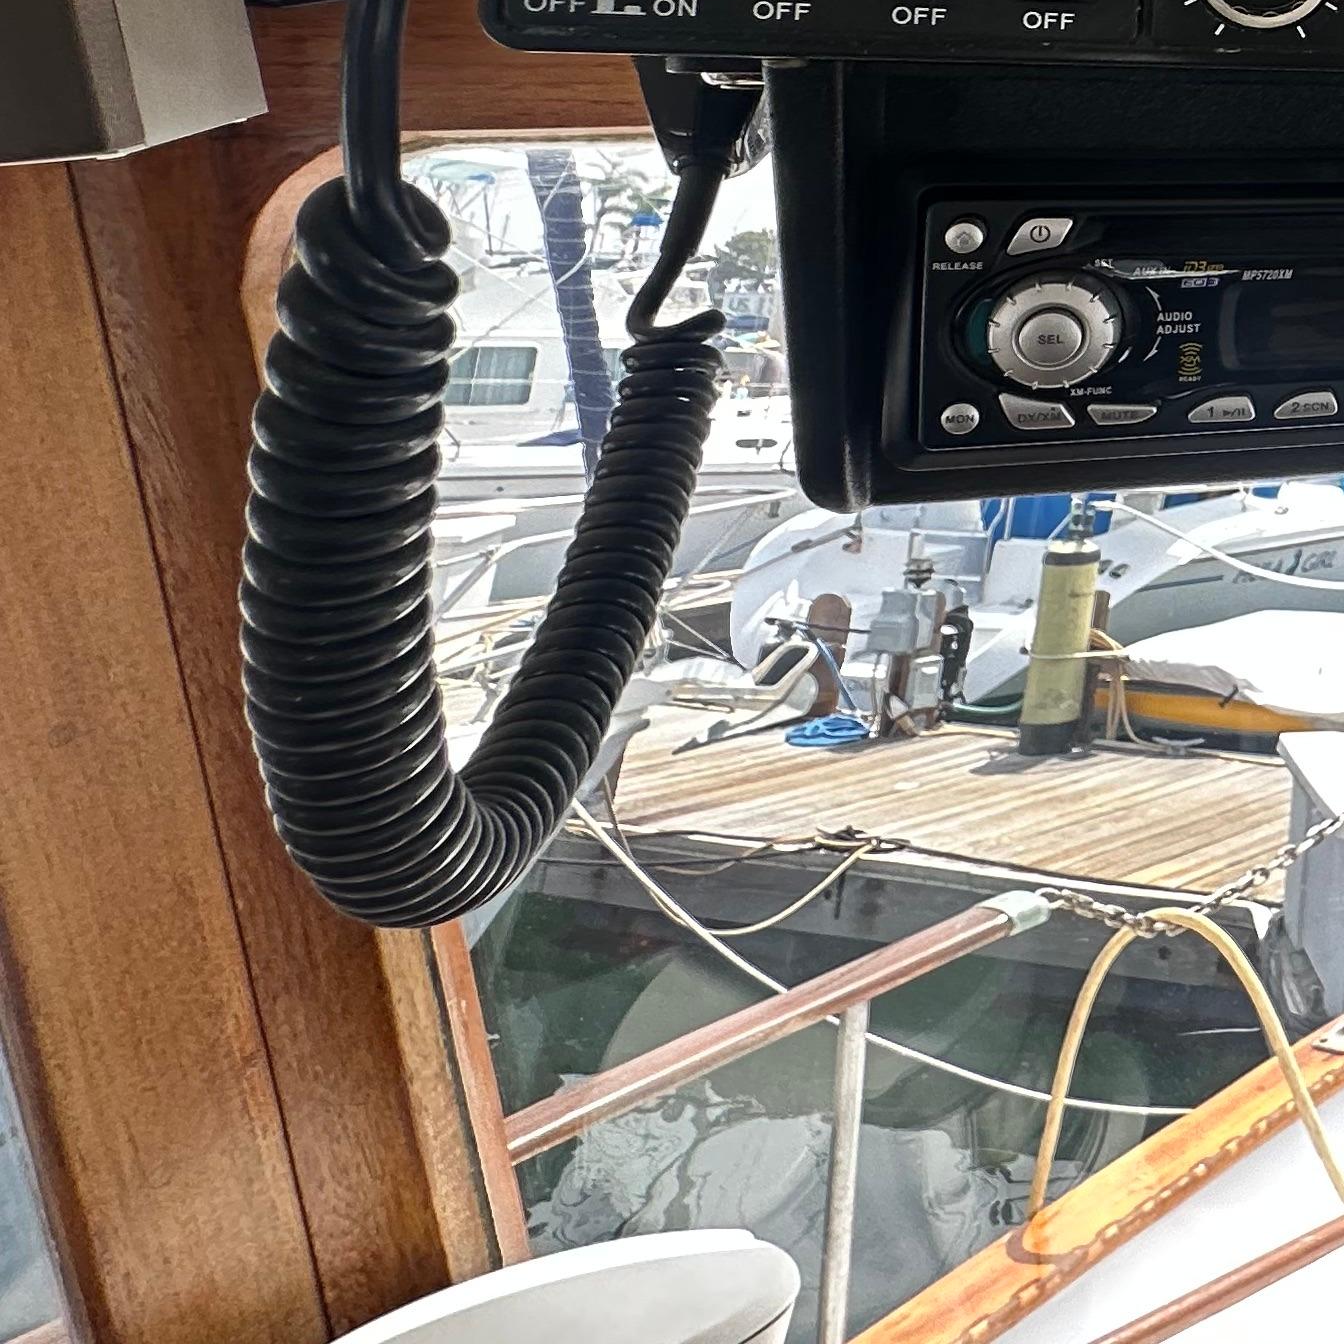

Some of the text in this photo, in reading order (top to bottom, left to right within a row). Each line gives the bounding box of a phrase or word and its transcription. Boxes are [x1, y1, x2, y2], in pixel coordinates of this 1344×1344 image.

[752, 1, 812, 21] OFF
[891, 6, 947, 26] OFF
[1022, 11, 1075, 30] OFF
[932, 262, 983, 271] RELEASE
[1157, 311, 1193, 322] AUDIO
[1156, 323, 1201, 335] ADJUST
[1037, 333, 1064, 345] SEL
[1069, 386, 1113, 397] XM-FUNC
[1208, 407, 1215, 417] 1
[1291, 401, 1330, 413] 2 SCN
[945, 414, 974, 424] MON
[1101, 408, 1139, 421] MUTE
